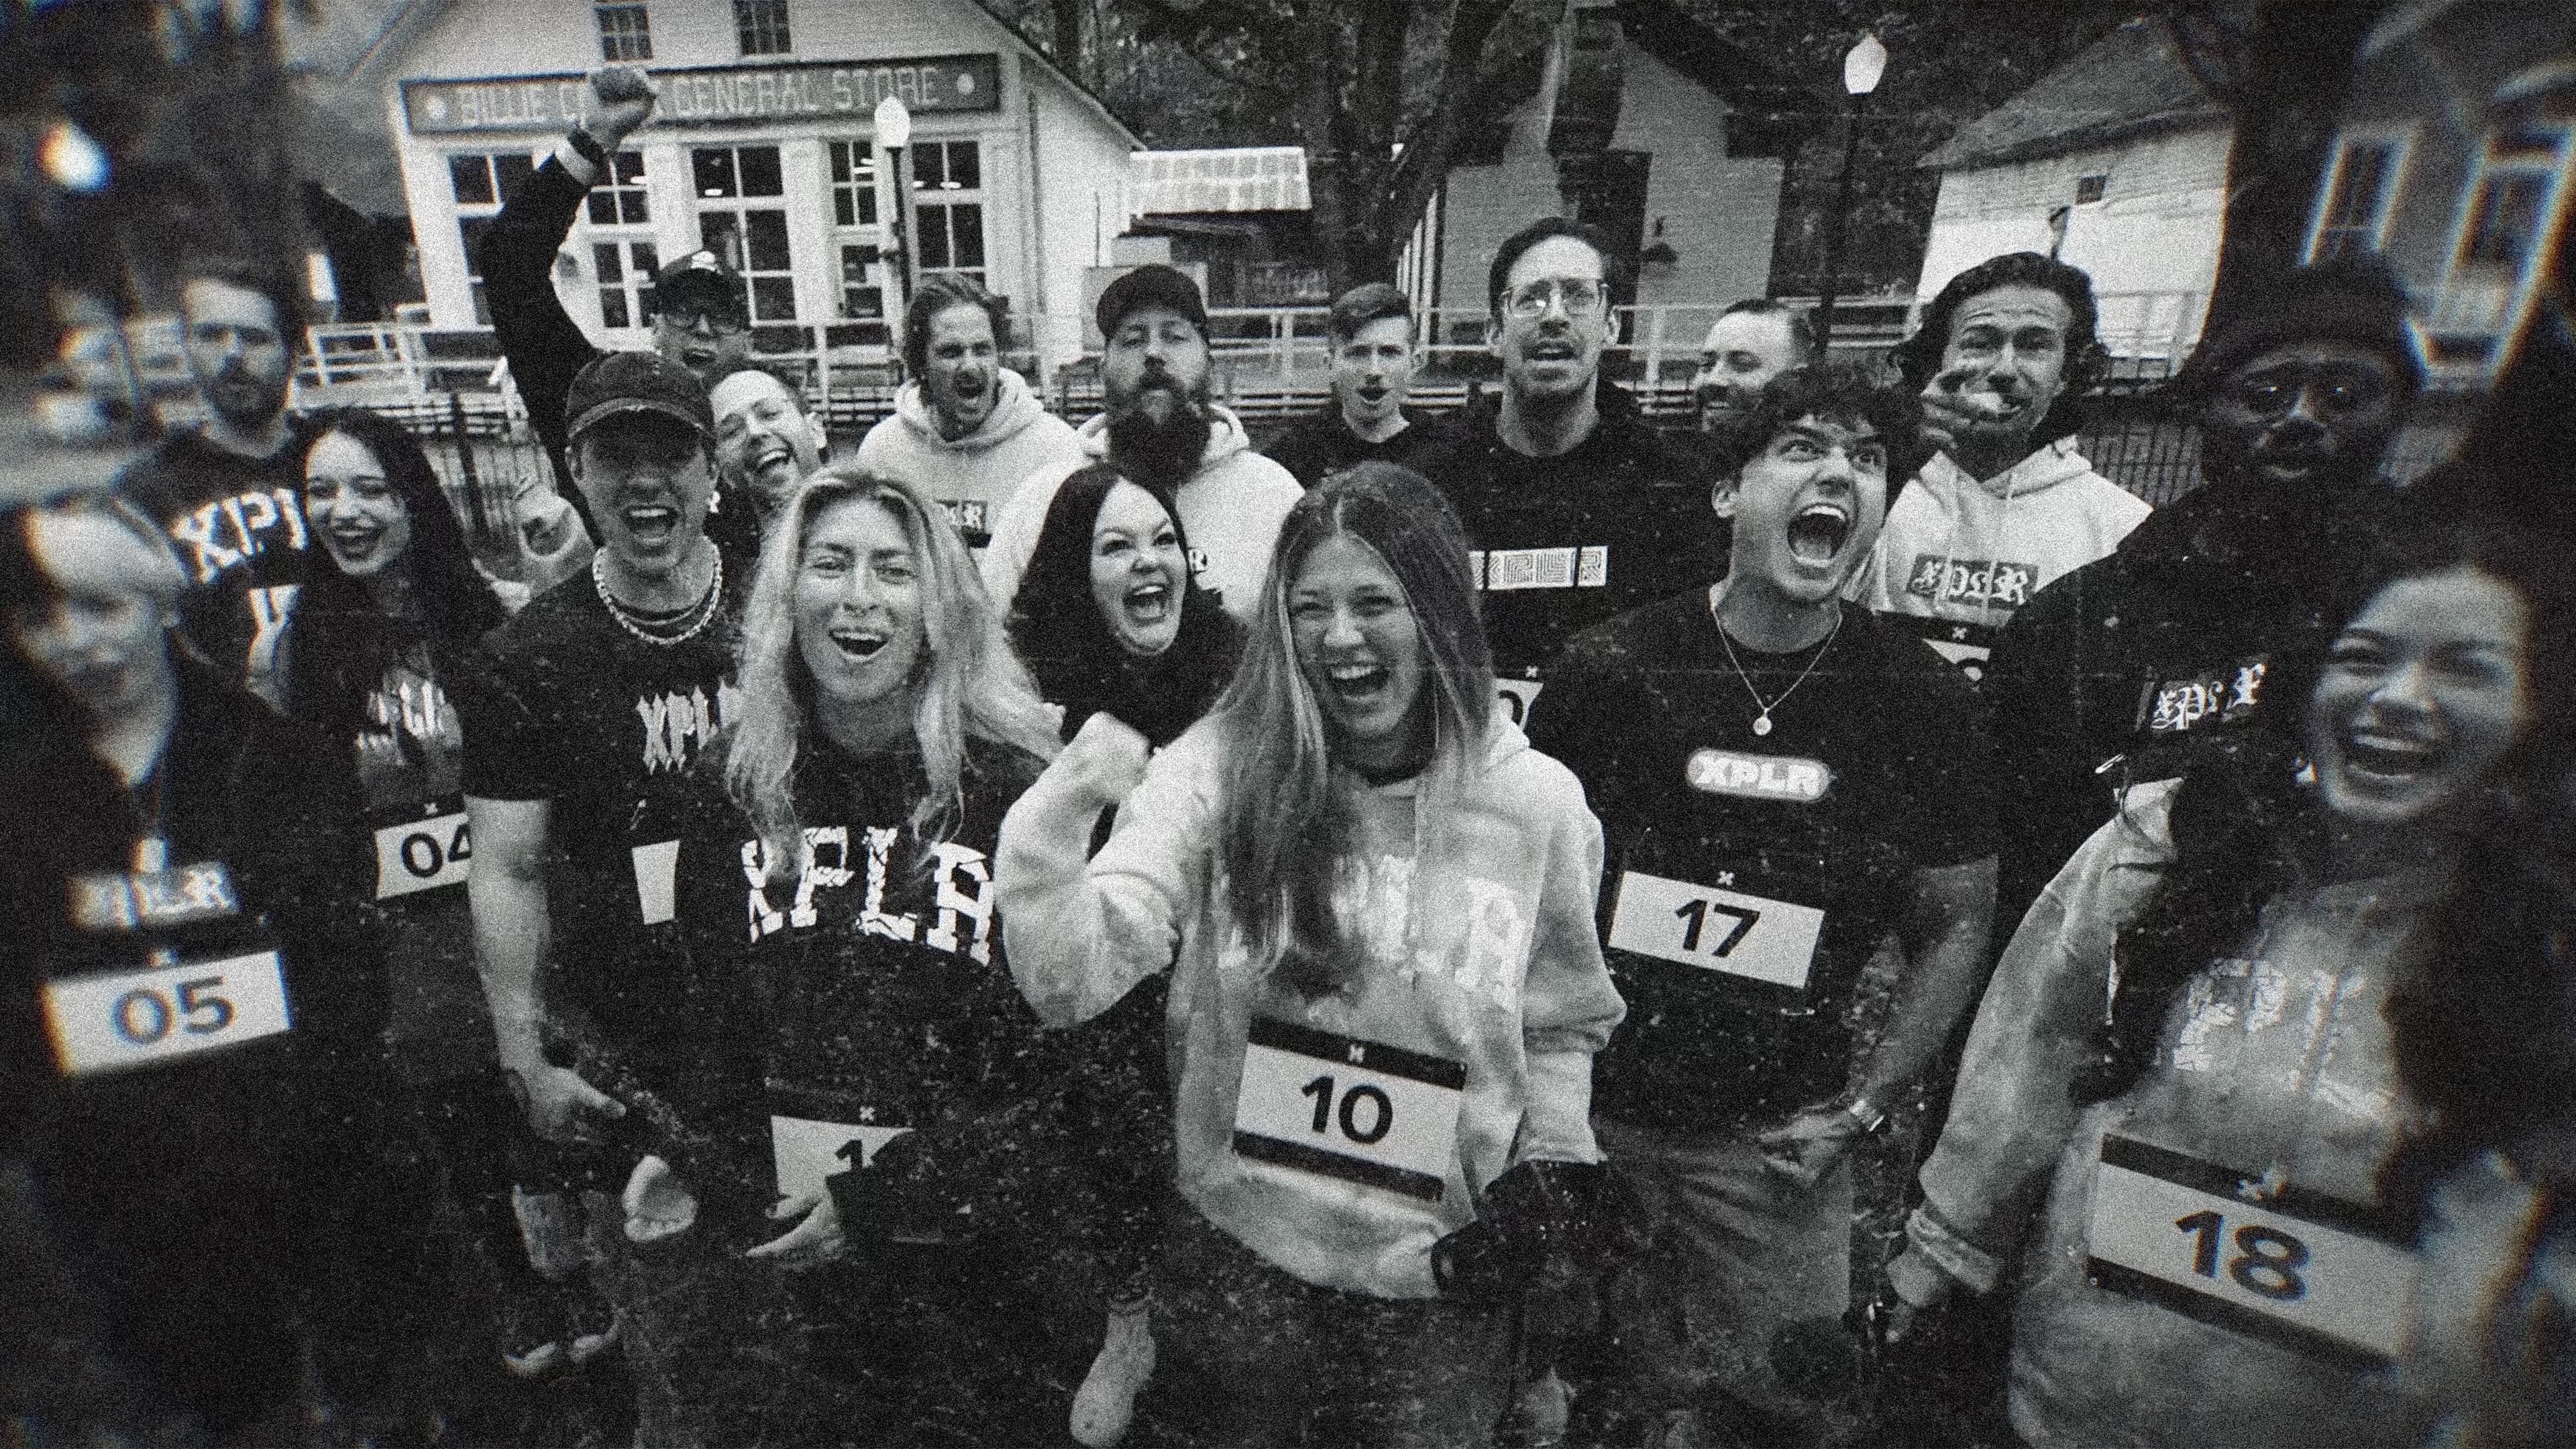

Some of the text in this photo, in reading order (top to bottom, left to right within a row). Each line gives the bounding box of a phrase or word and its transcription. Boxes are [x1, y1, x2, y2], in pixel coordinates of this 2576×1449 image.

[456, 84, 547, 126] BILLIE
[672, 72, 820, 117] GENERAL
[832, 65, 940, 111] STORE
[1694, 755, 1819, 797] XPLR
[401, 822, 472, 878] 04
[1676, 898, 1761, 959] 17
[110, 976, 235, 1046] 05
[1301, 1075, 1394, 1145] 10
[2174, 1210, 2312, 1302] 18
